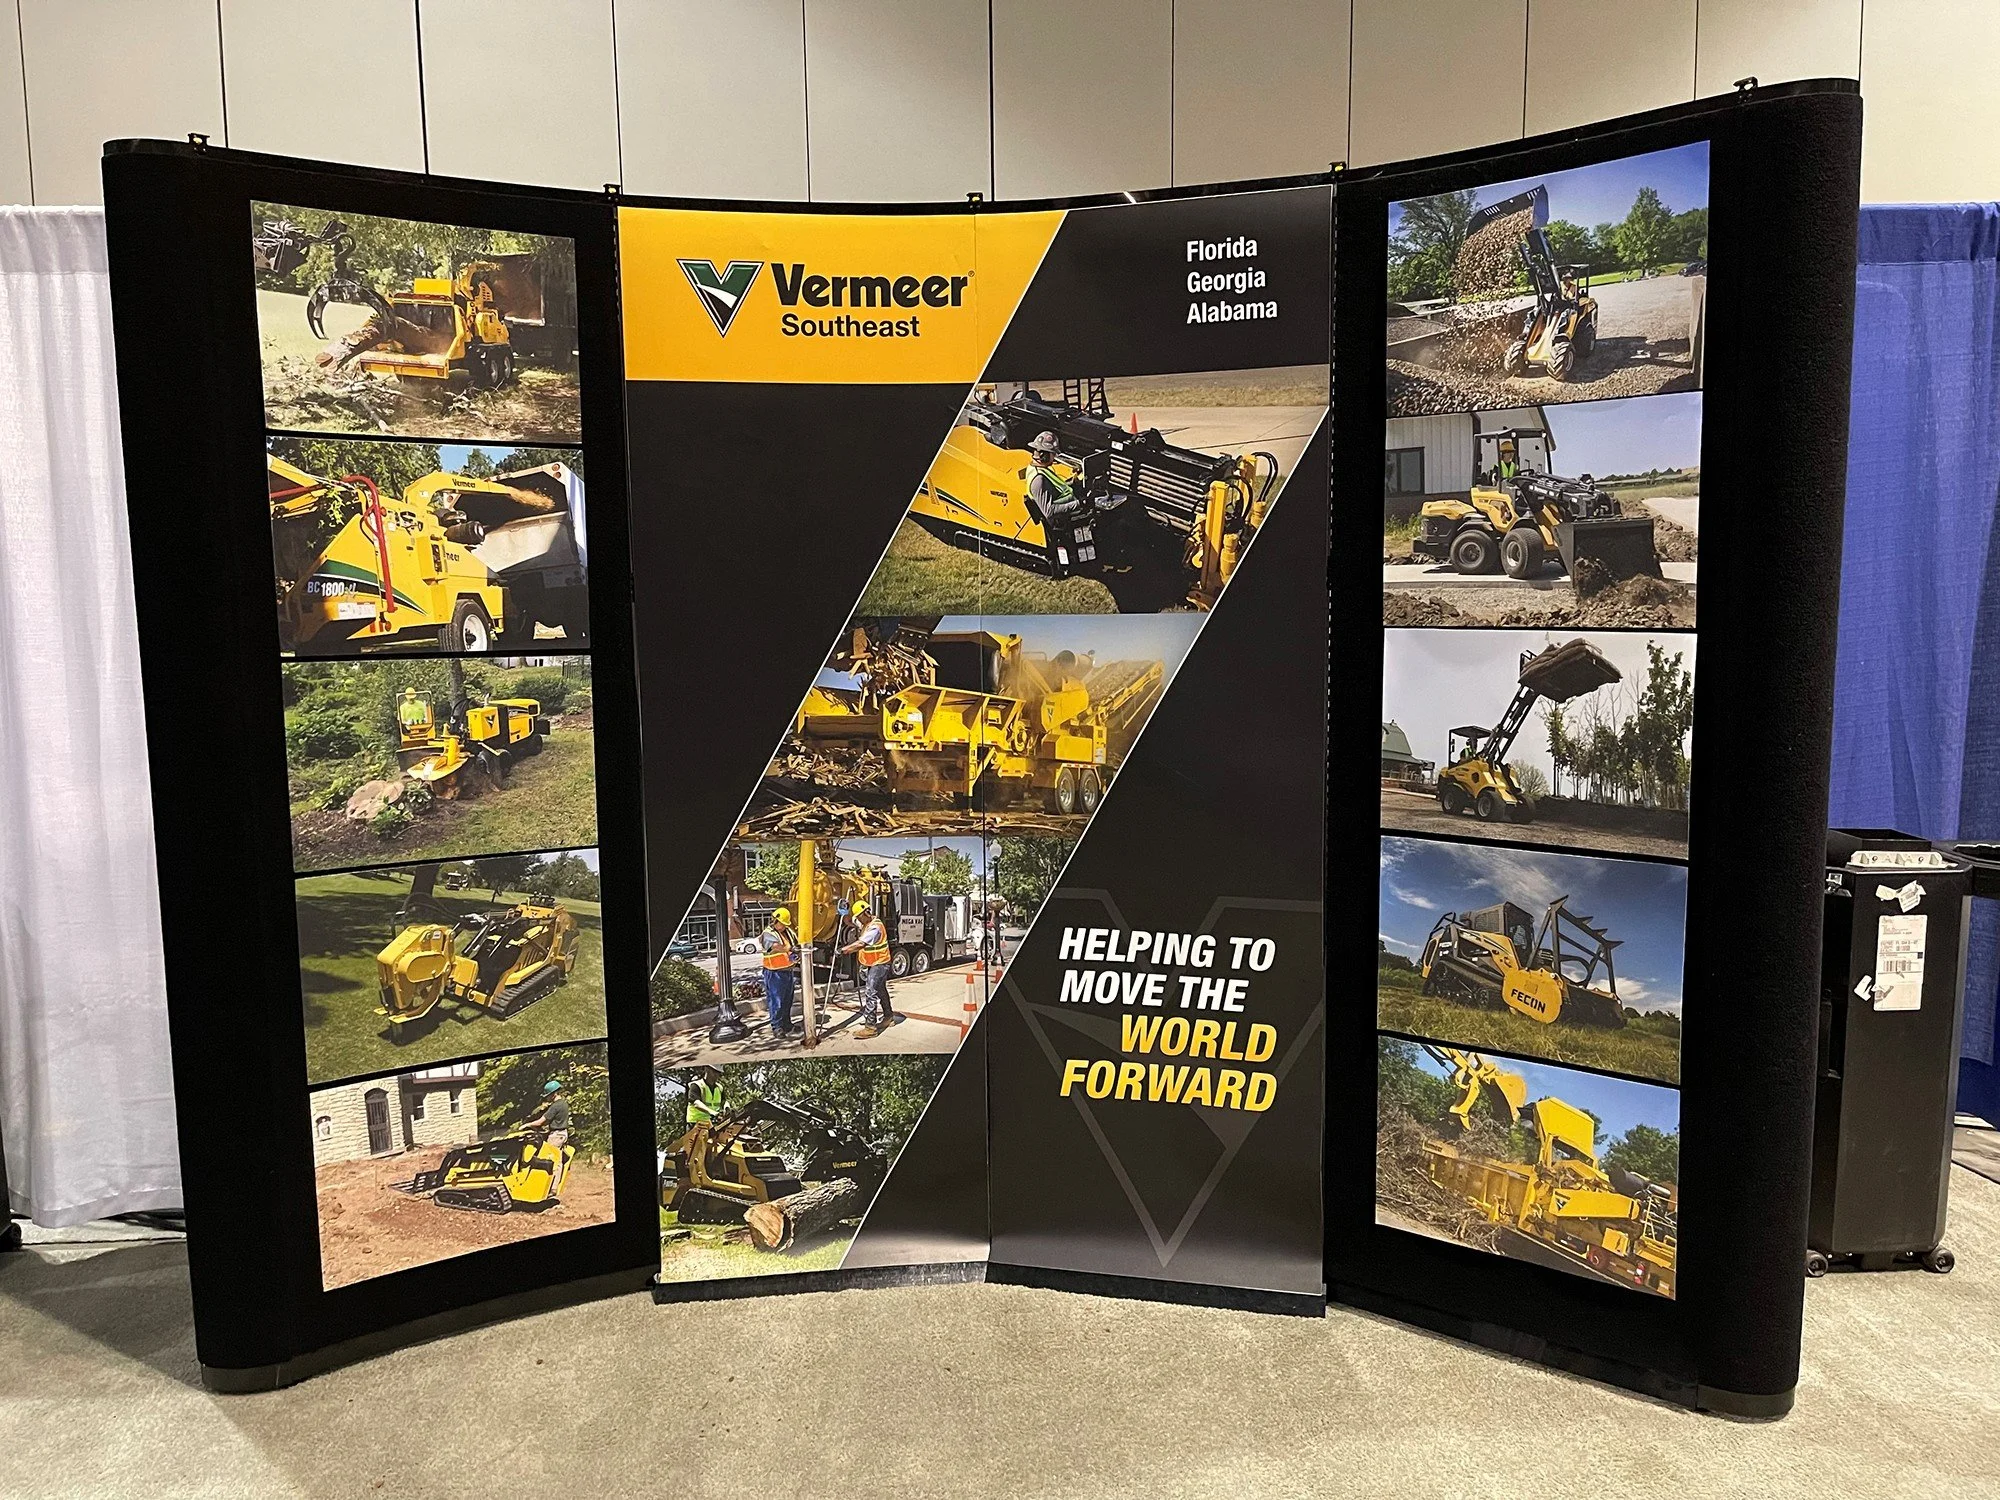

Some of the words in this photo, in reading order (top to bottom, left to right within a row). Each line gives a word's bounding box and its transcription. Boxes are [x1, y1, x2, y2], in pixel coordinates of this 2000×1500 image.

[1187, 236, 1258, 262] Florida
[770, 262, 968, 308] Vermeer
[1187, 267, 1266, 294] Georgia
[781, 313, 920, 338] Southeast
[1186, 300, 1278, 324] Alabama
[307, 581, 320, 593] BC
[321, 581, 345, 597] 1800
[1058, 927, 1216, 968] HELPING
[1229, 936, 1276, 972] TO
[1059, 969, 1168, 1007] MOVE
[1178, 975, 1250, 1013] THE
[1510, 988, 1546, 1014] FECON
[1121, 1014, 1278, 1063] WORLD
[1059, 1059, 1278, 1112] FORWARD
